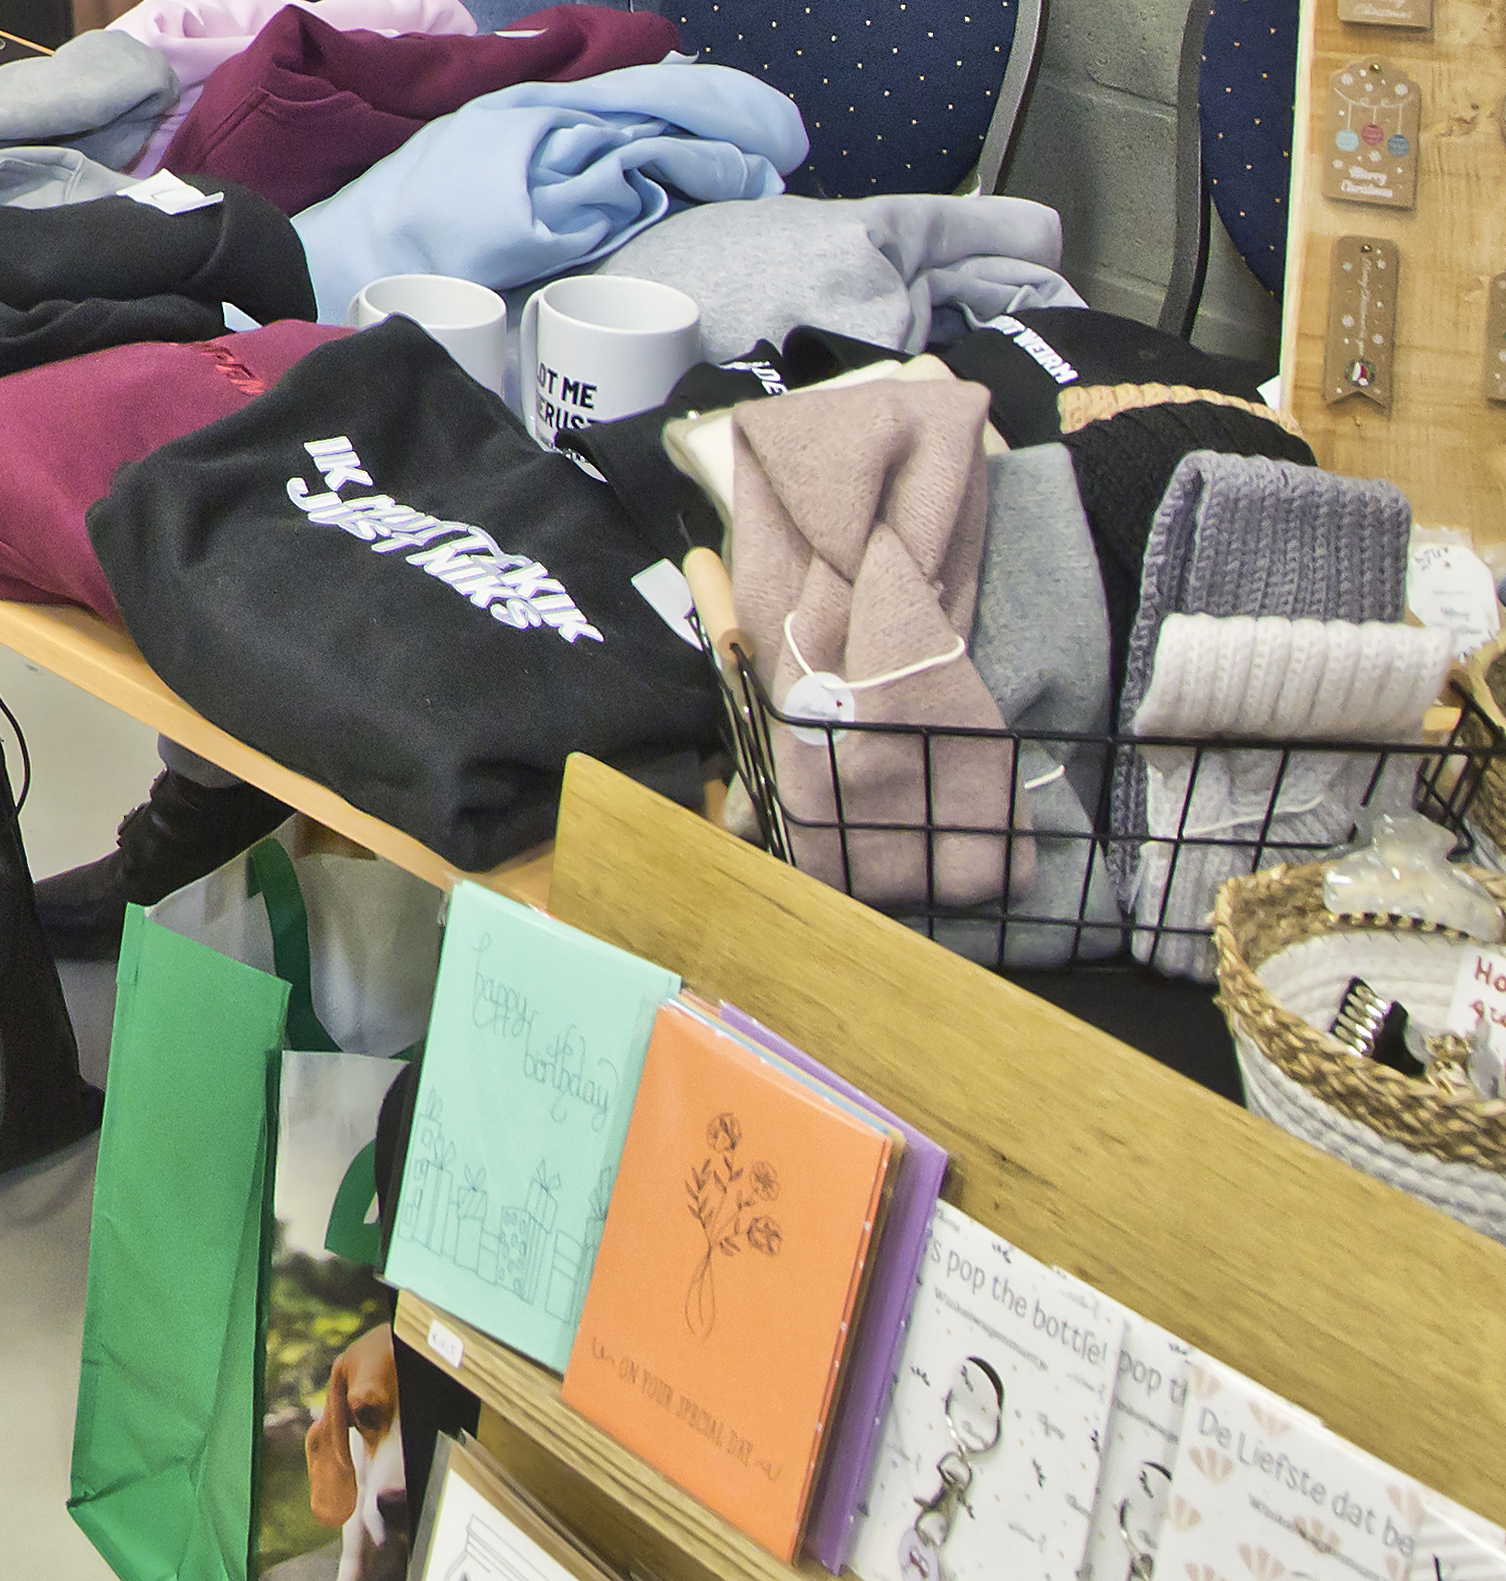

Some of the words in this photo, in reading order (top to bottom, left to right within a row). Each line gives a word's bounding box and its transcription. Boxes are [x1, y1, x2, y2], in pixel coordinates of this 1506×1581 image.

[537, 362, 559, 395] OT
[561, 376, 598, 410] ME
[304, 435, 374, 492] IK
[405, 544, 542, 630] NIKS
[946, 1249, 987, 1295] pop
[992, 1274, 1029, 1319] the
